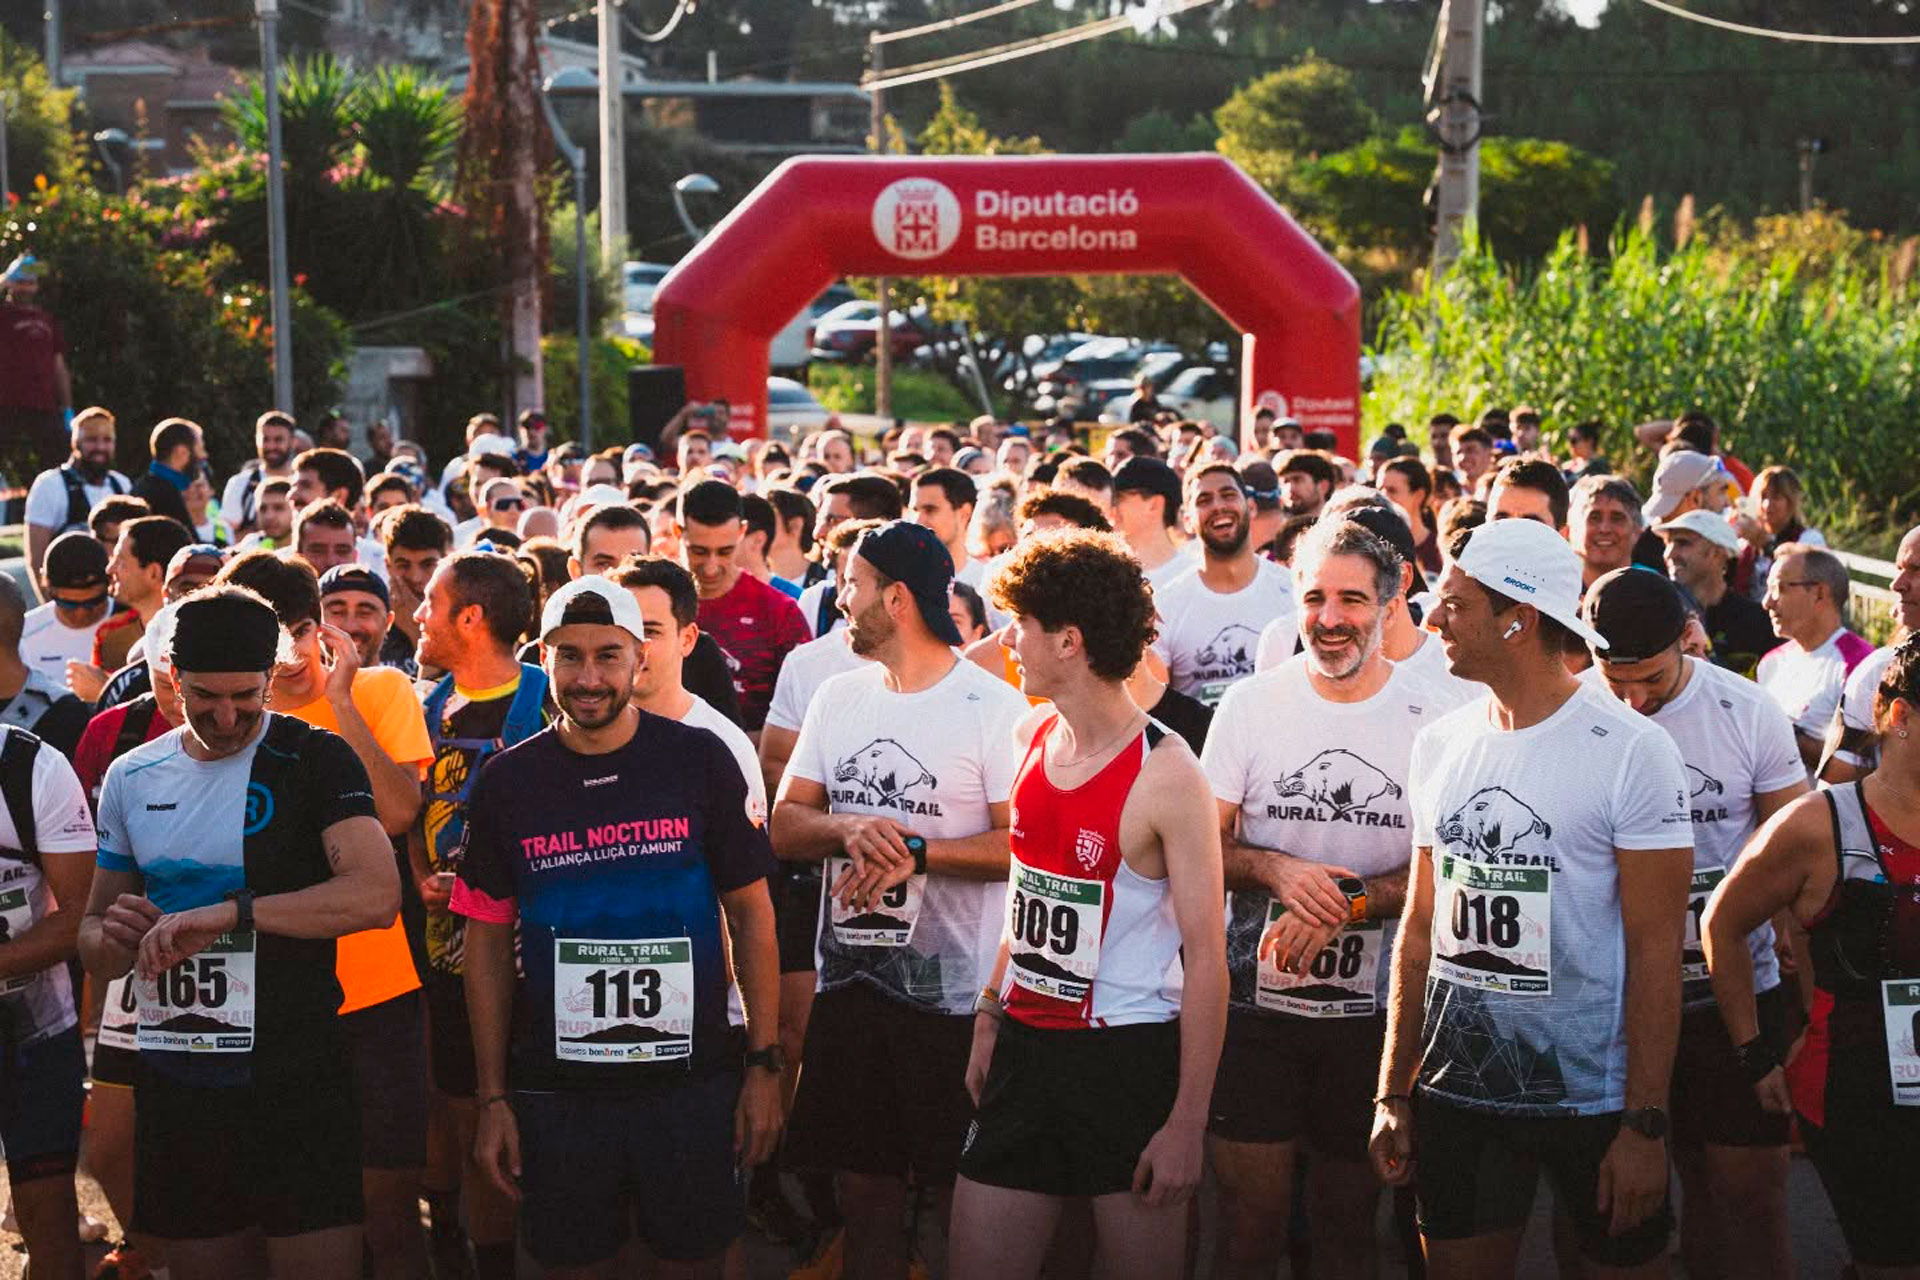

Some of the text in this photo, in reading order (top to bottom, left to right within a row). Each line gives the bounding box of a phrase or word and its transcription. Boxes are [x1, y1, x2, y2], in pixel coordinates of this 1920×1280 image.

[975, 188, 1139, 223] Diputació
[975, 224, 1138, 250] Barcelona
[1503, 576, 1537, 594] BROOKS
[831, 789, 943, 817] RURAL TRAIL
[1267, 804, 1406, 829] RURAL TRAIL
[1691, 807, 1729, 823] RAIL
[521, 817, 690, 860] TRAIL NOCTURN
[530, 853, 592, 872] L'ALIANÇA
[629, 840, 683, 856] D'AMUNT
[2, 866, 27, 881] AIL
[1045, 877, 1082, 896] TRAIL
[1482, 869, 1528, 883] TRAIL
[1691, 874, 1710, 885] AIL
[1011, 890, 1080, 955] 009
[1451, 888, 1520, 949] 018
[578, 944, 672, 957] RURAL TRAIL
[1281, 934, 1365, 979] 68
[157, 957, 228, 1009] 165
[585, 968, 662, 1019] 113
